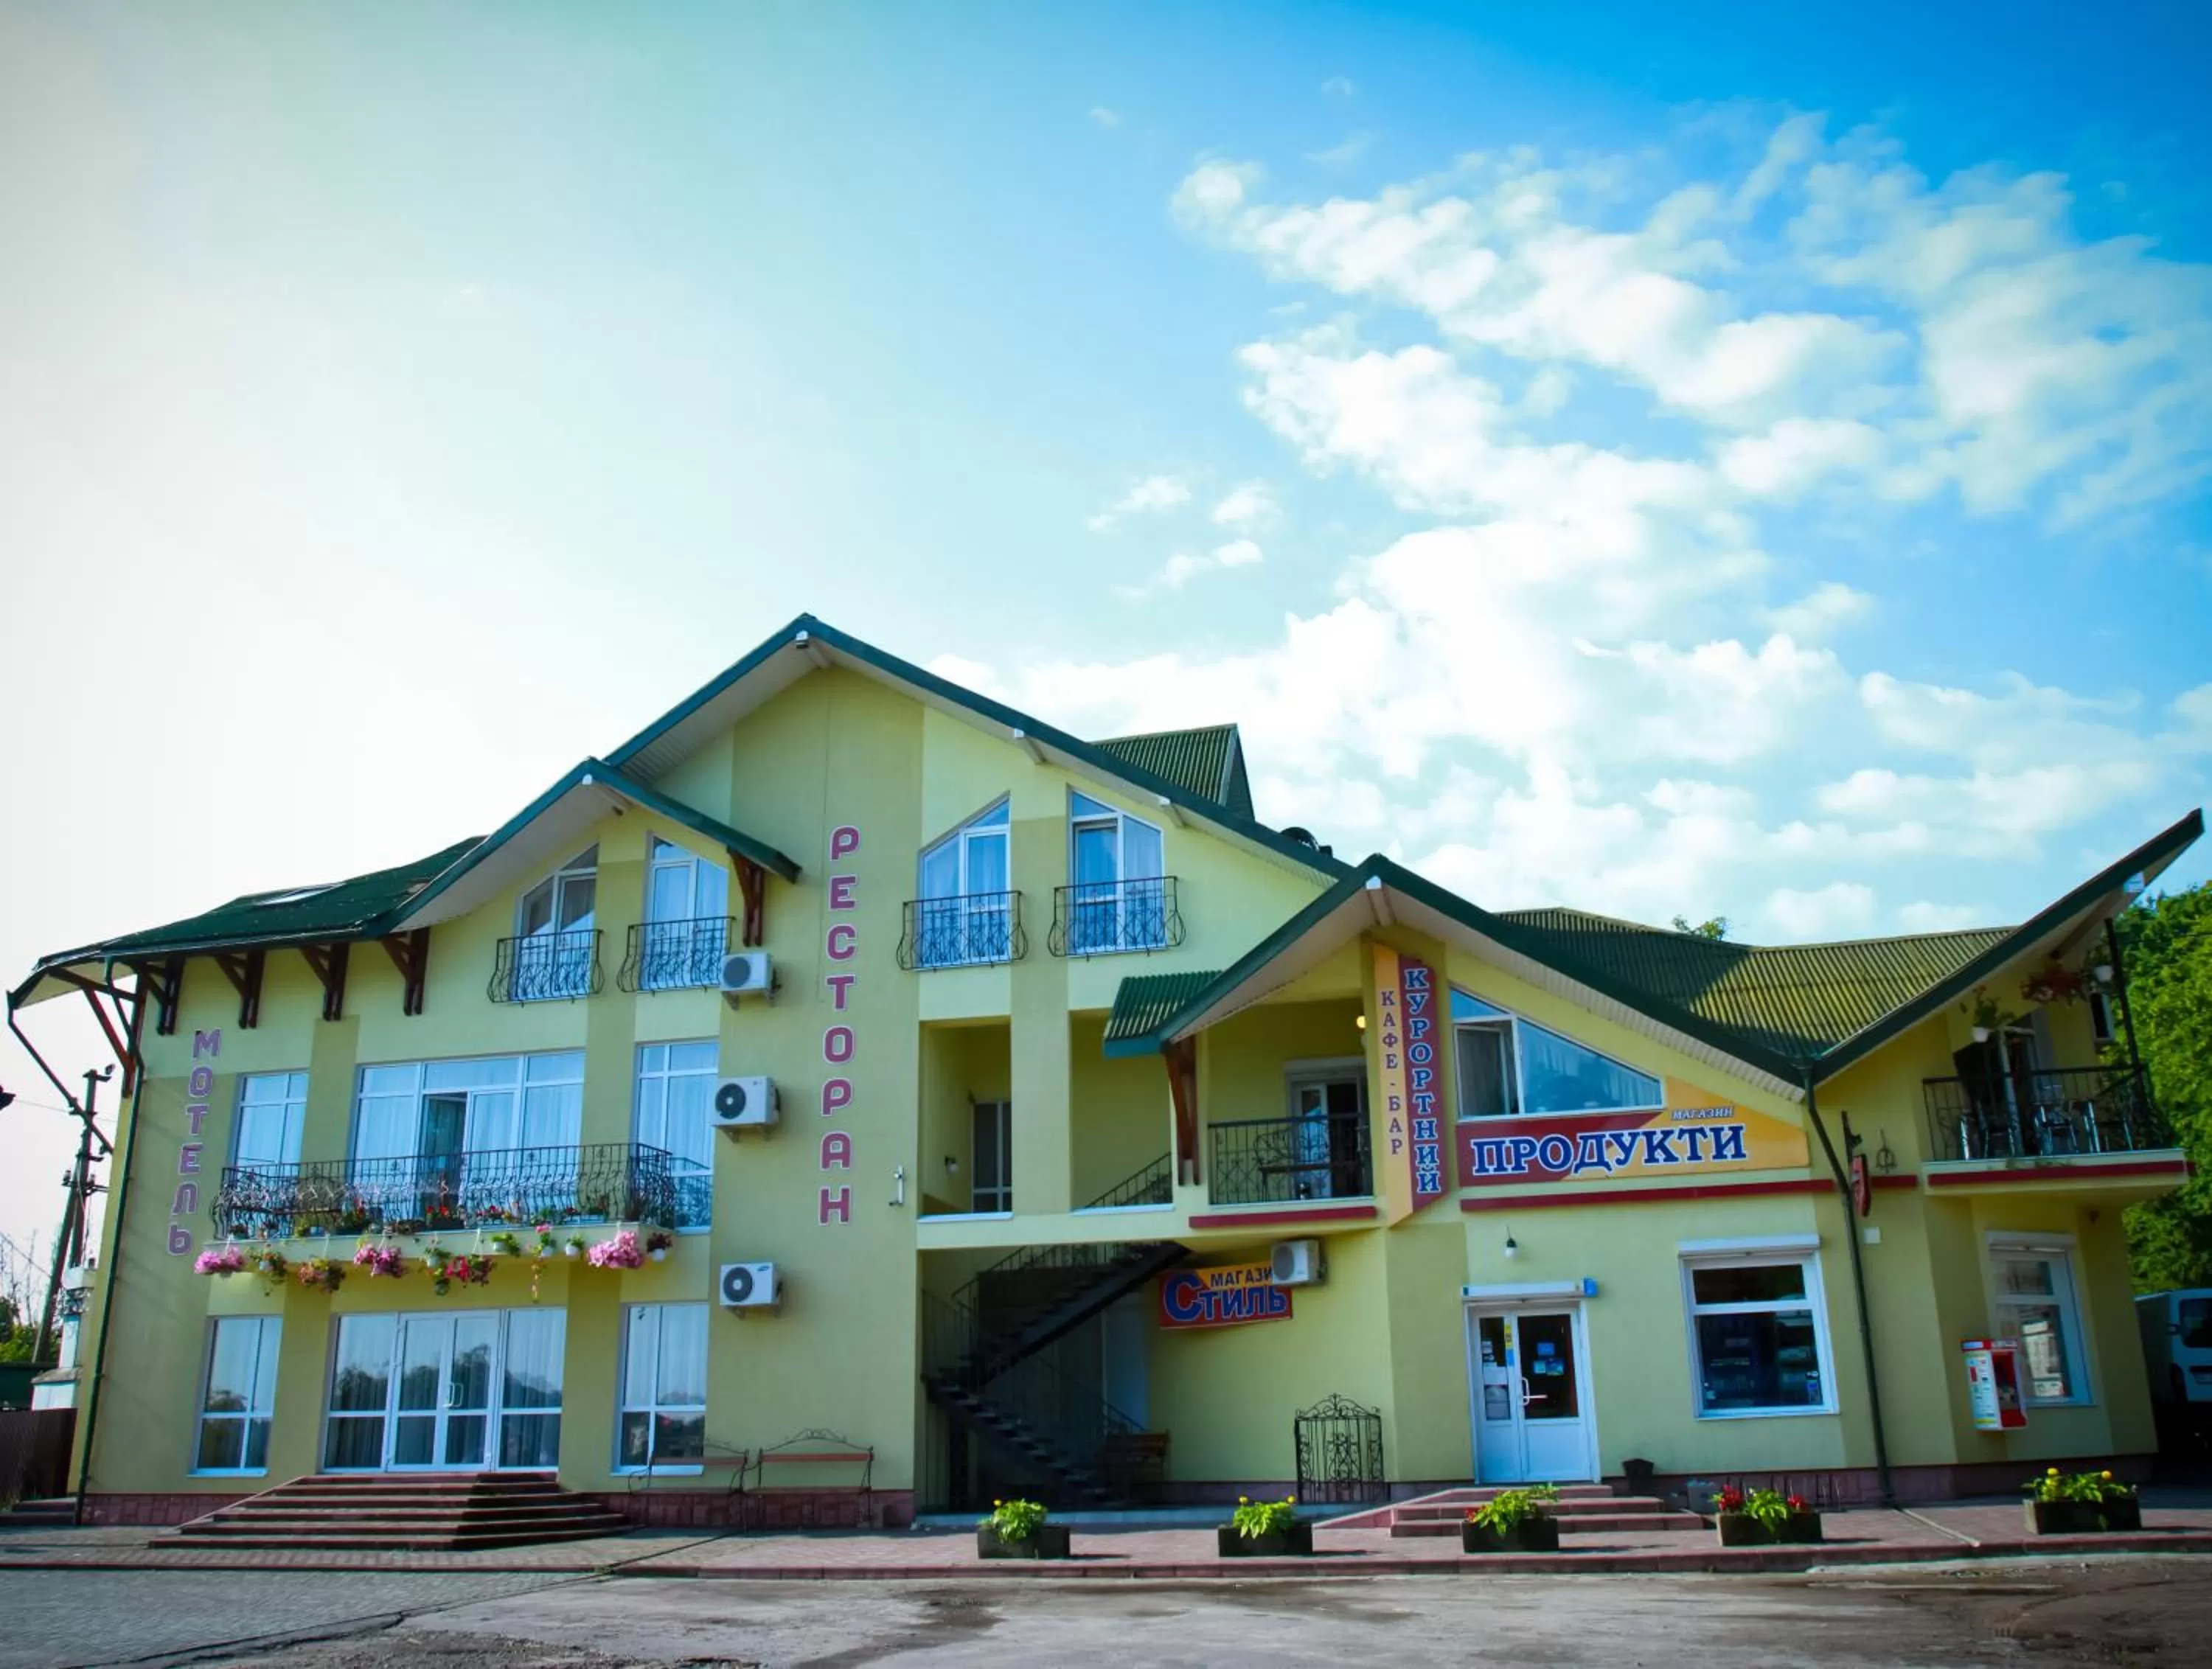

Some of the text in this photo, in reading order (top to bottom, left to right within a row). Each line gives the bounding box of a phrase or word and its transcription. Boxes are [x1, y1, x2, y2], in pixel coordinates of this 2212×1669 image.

[818, 826, 860, 1225] РЕСТОРАН
[1404, 968, 1441, 1194] КУРОРТНИЙ
[167, 1028, 221, 1255] МОТЕЛЬ
[1471, 1123, 1748, 1176] ПРОДУКТИ
[1671, 1106, 1734, 1121] МАГАЗИН
[1211, 1266, 1273, 1287] МАГАЗИ
